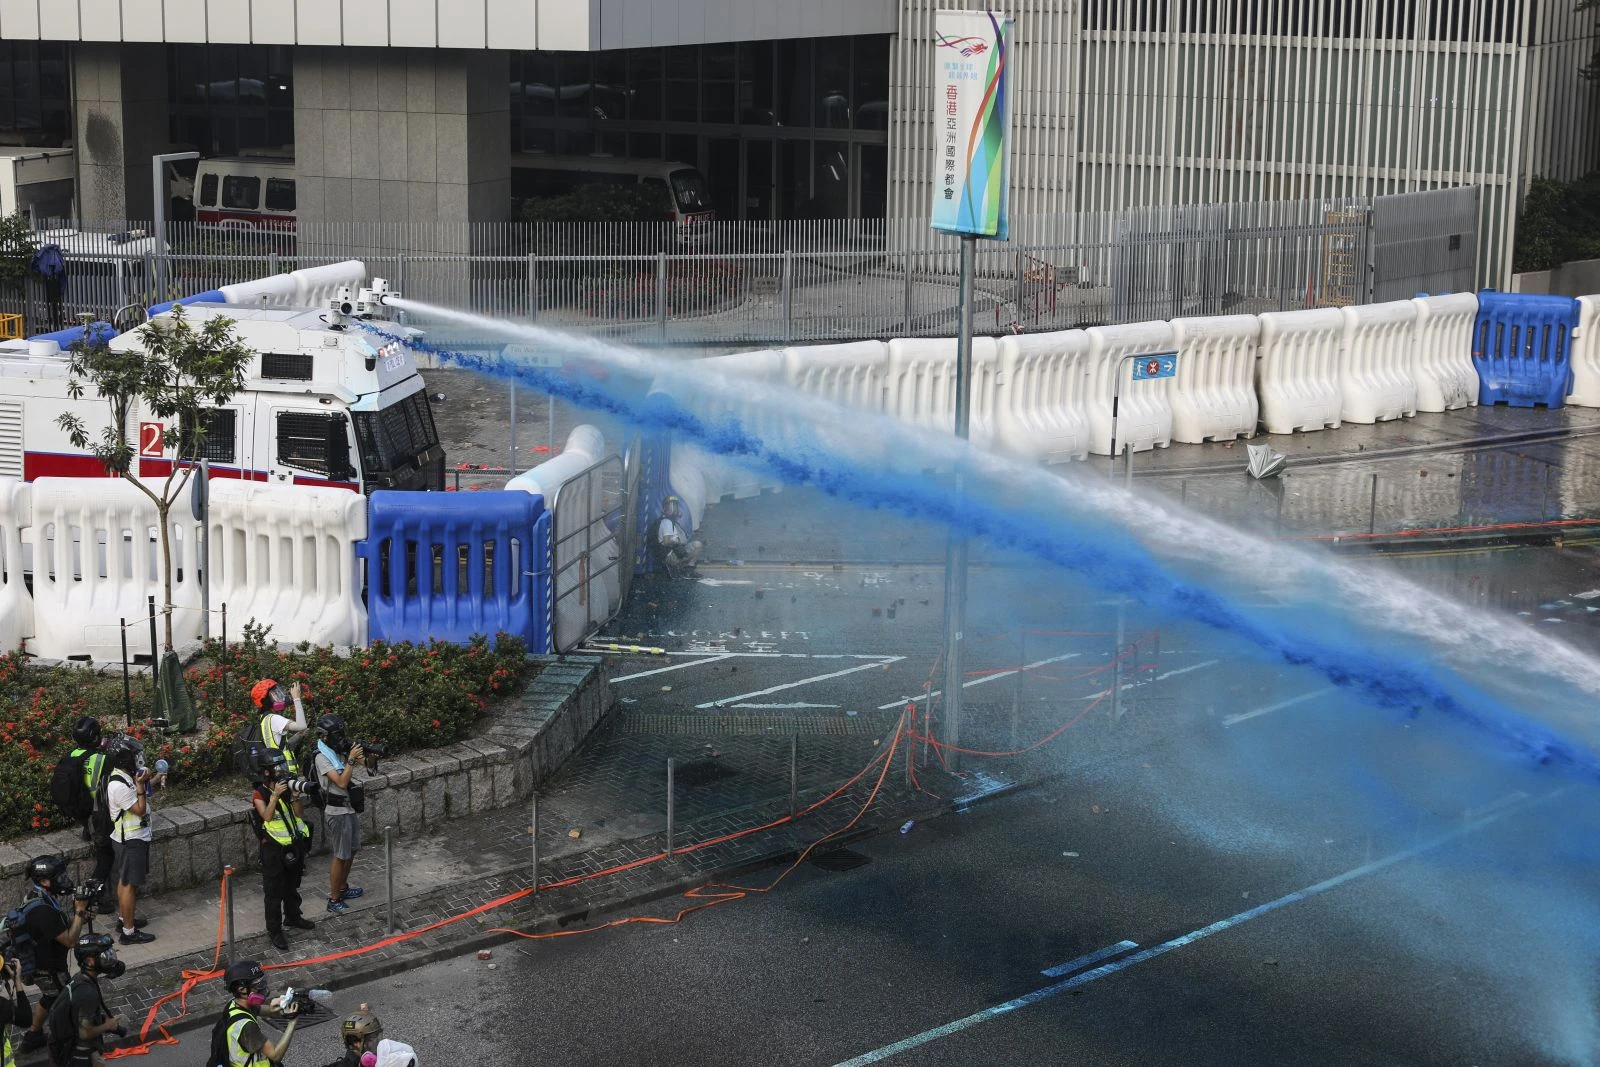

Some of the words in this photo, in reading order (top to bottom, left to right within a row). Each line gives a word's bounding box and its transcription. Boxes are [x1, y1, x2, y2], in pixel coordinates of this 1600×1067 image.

[944, 84, 957, 200] 香港亞洲國際都會
[142, 424, 161, 455] 2
[743, 630, 811, 640] LEFT
